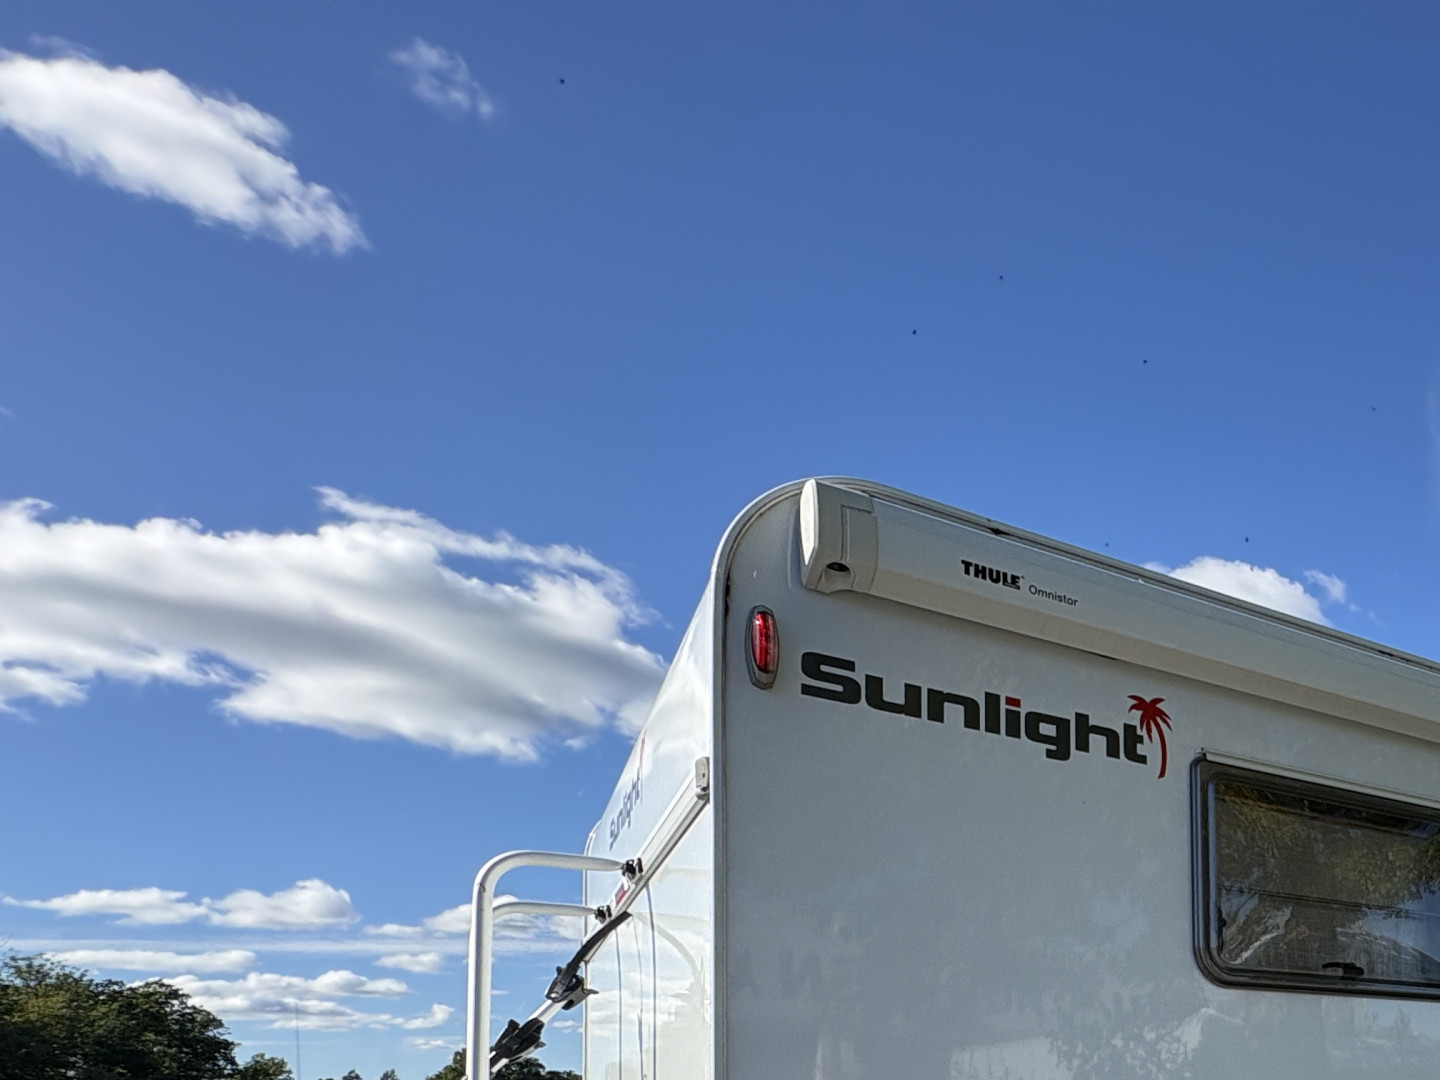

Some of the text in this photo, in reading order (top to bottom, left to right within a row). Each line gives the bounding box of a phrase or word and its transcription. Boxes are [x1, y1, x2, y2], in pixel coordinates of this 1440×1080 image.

[961, 559, 1079, 607] THULE Omnistor
[801, 652, 1148, 765] Sunlight
